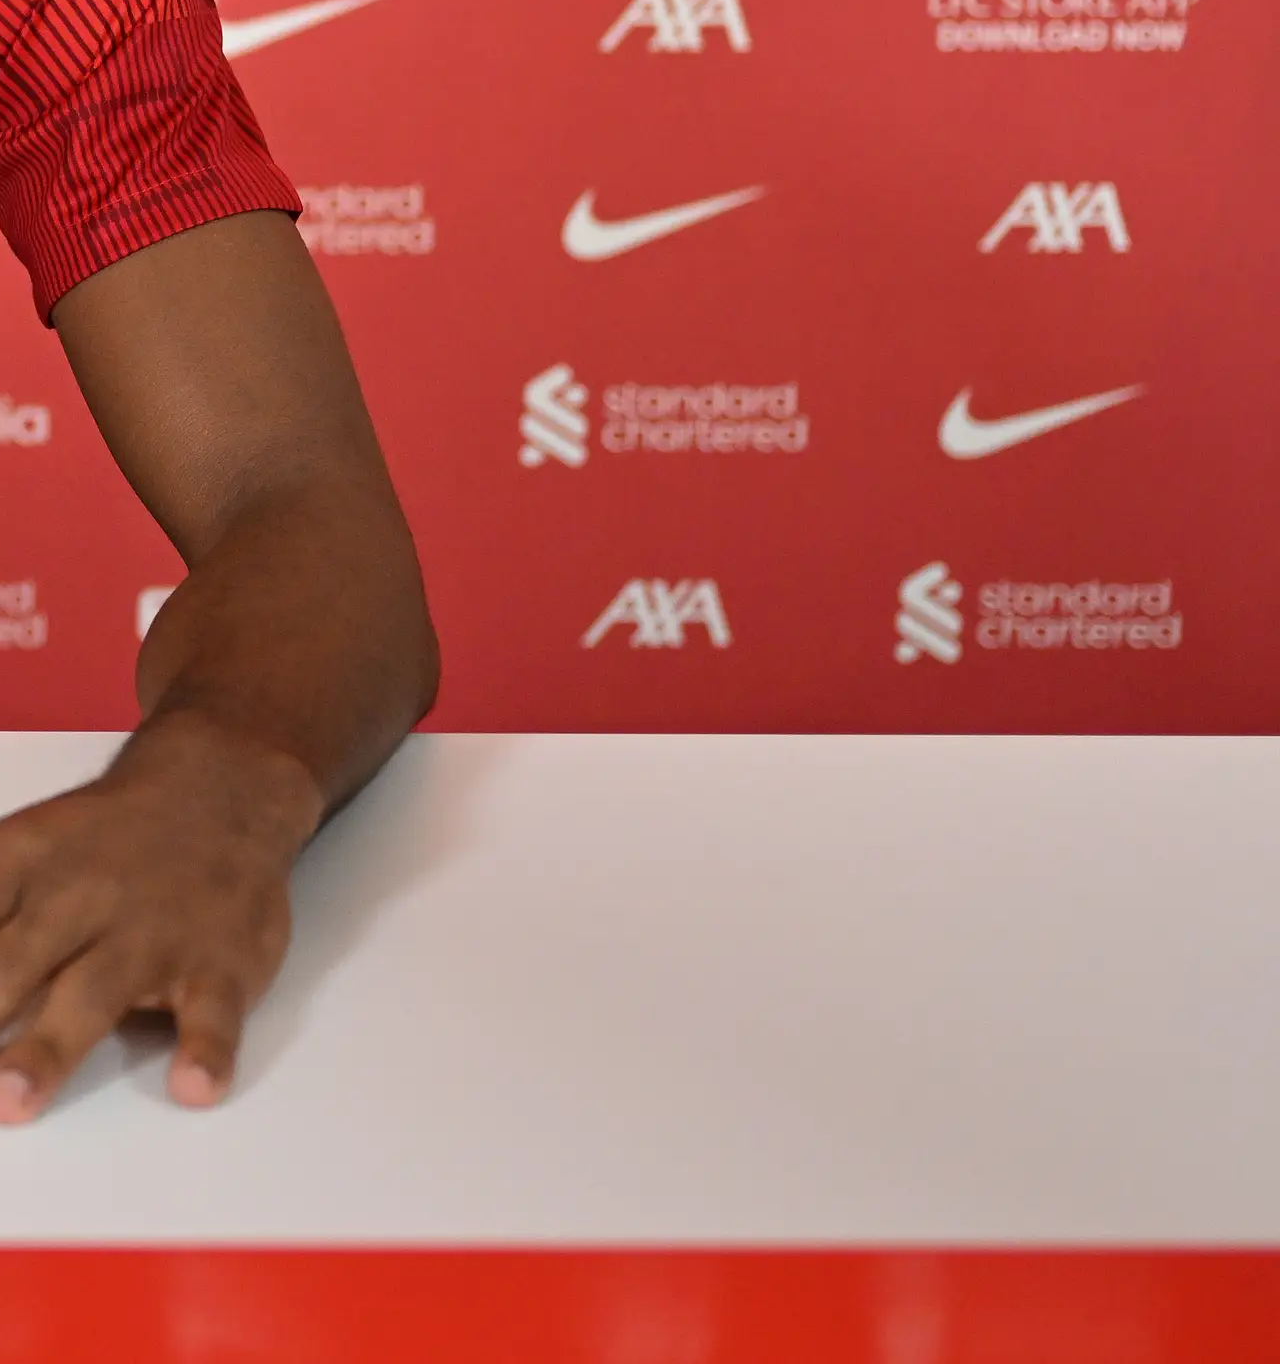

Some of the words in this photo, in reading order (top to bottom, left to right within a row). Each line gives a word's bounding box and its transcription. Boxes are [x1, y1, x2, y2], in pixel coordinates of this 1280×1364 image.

[981, 182, 1130, 252] AXA
[603, 382, 797, 419] standard
[601, 416, 809, 453] chartered
[583, 579, 730, 648] AXA
[979, 579, 1171, 615] standard
[976, 612, 1183, 649] chartered
